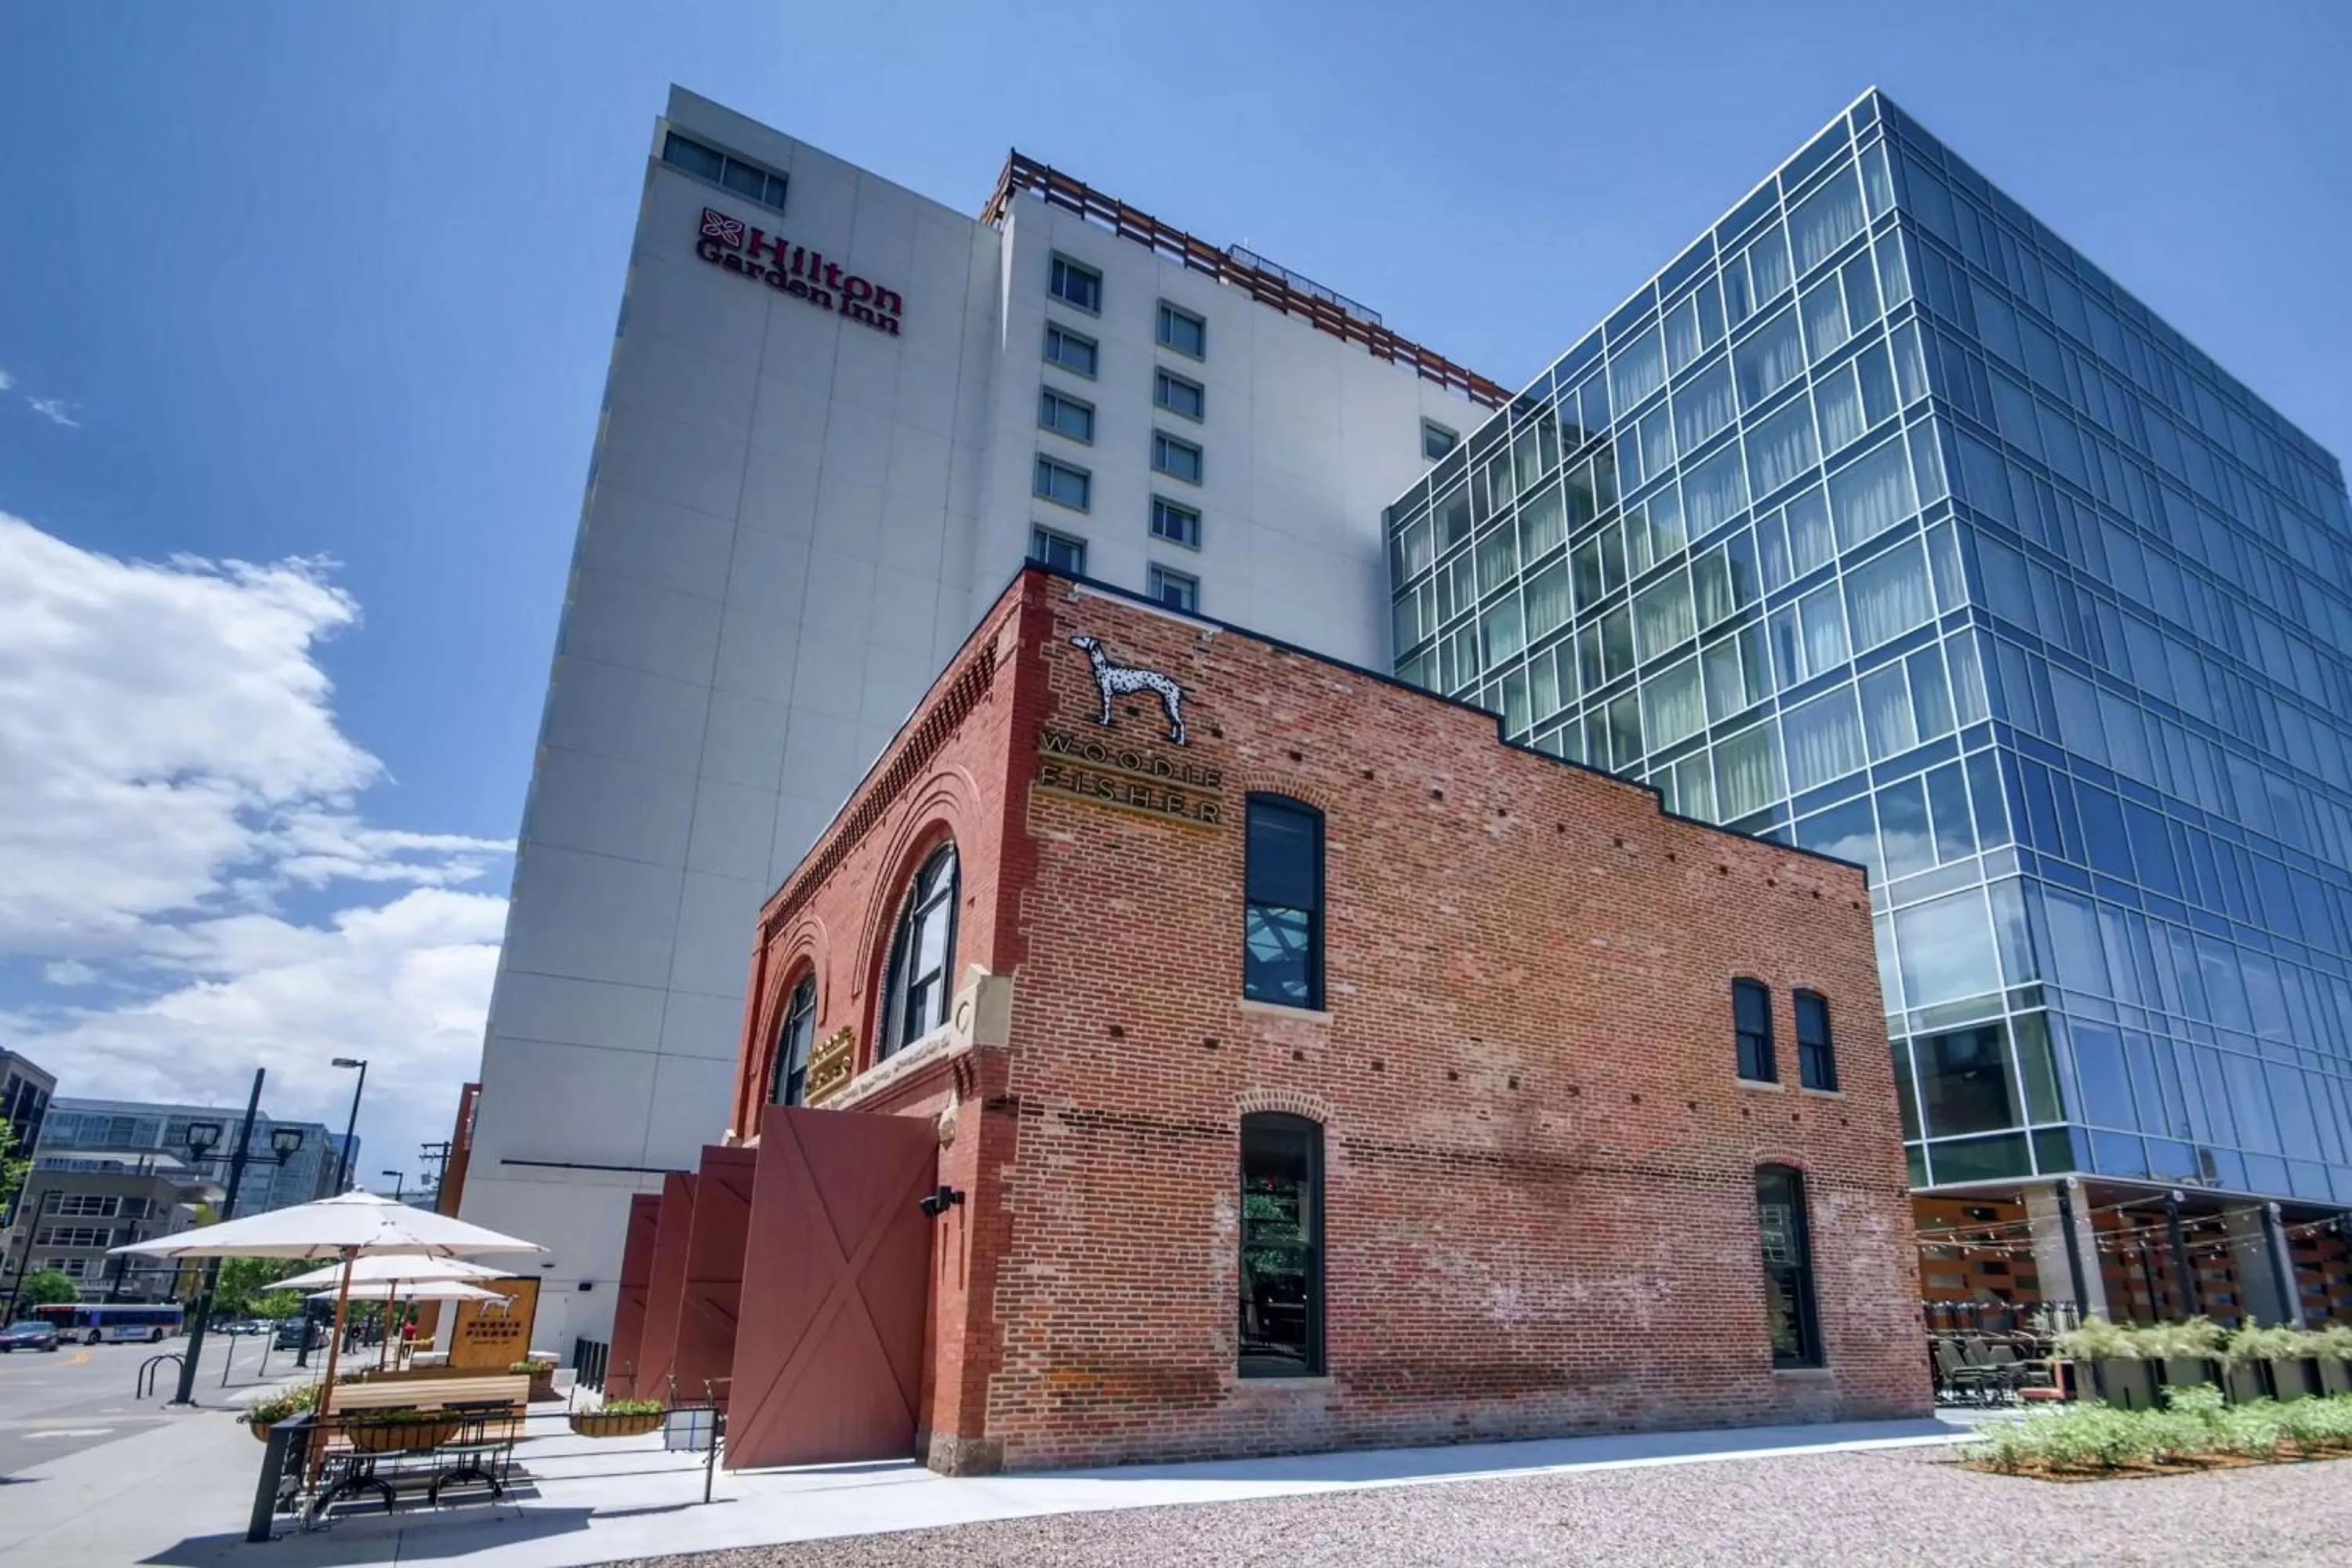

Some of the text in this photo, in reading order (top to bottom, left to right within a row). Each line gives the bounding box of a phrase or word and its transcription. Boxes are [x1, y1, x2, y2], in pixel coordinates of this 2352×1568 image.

[696, 238, 899, 336] Garden Inn
[747, 226, 903, 317] Hilton
[1040, 731, 1221, 790] WOODIE
[1040, 765, 1220, 824] FISHER
